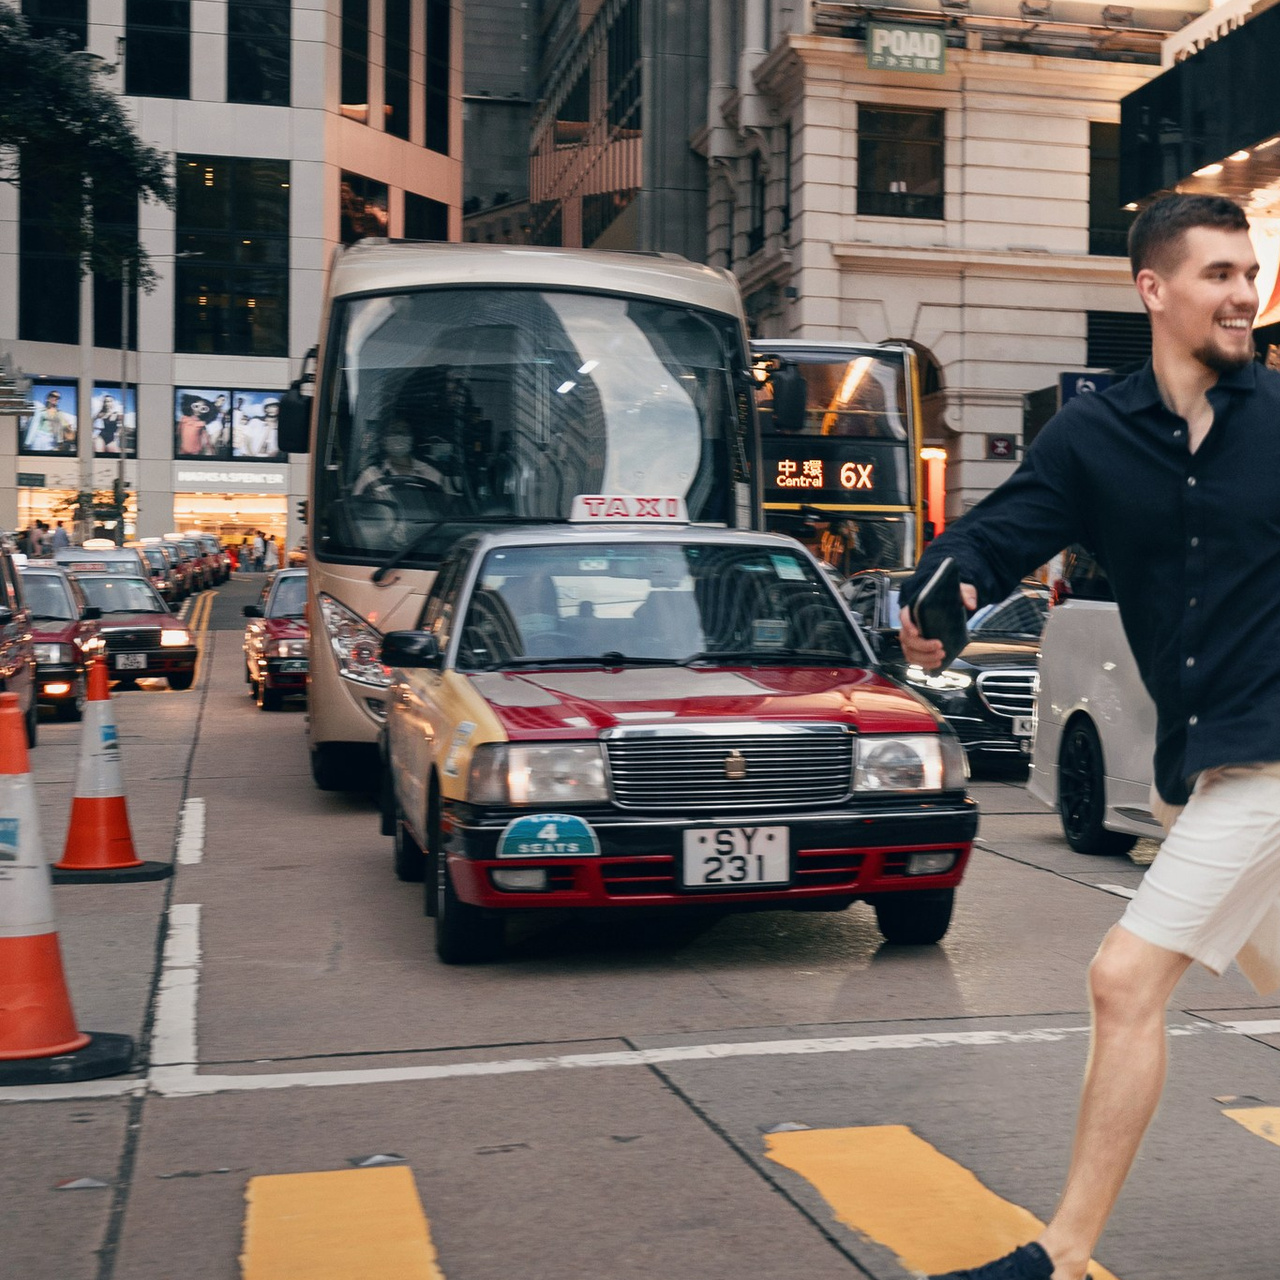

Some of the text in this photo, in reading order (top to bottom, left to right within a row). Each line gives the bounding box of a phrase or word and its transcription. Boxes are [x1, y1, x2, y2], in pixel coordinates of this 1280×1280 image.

[872, 28, 941, 58] POAD
[778, 459, 823, 477] 中環
[840, 462, 873, 489] 6X
[776, 475, 823, 488] Central
[582, 497, 678, 518] TAXI
[537, 823, 559, 841] 4
[715, 827, 758, 856] SY
[518, 843, 579, 853] SEATS
[703, 855, 764, 883] 231
